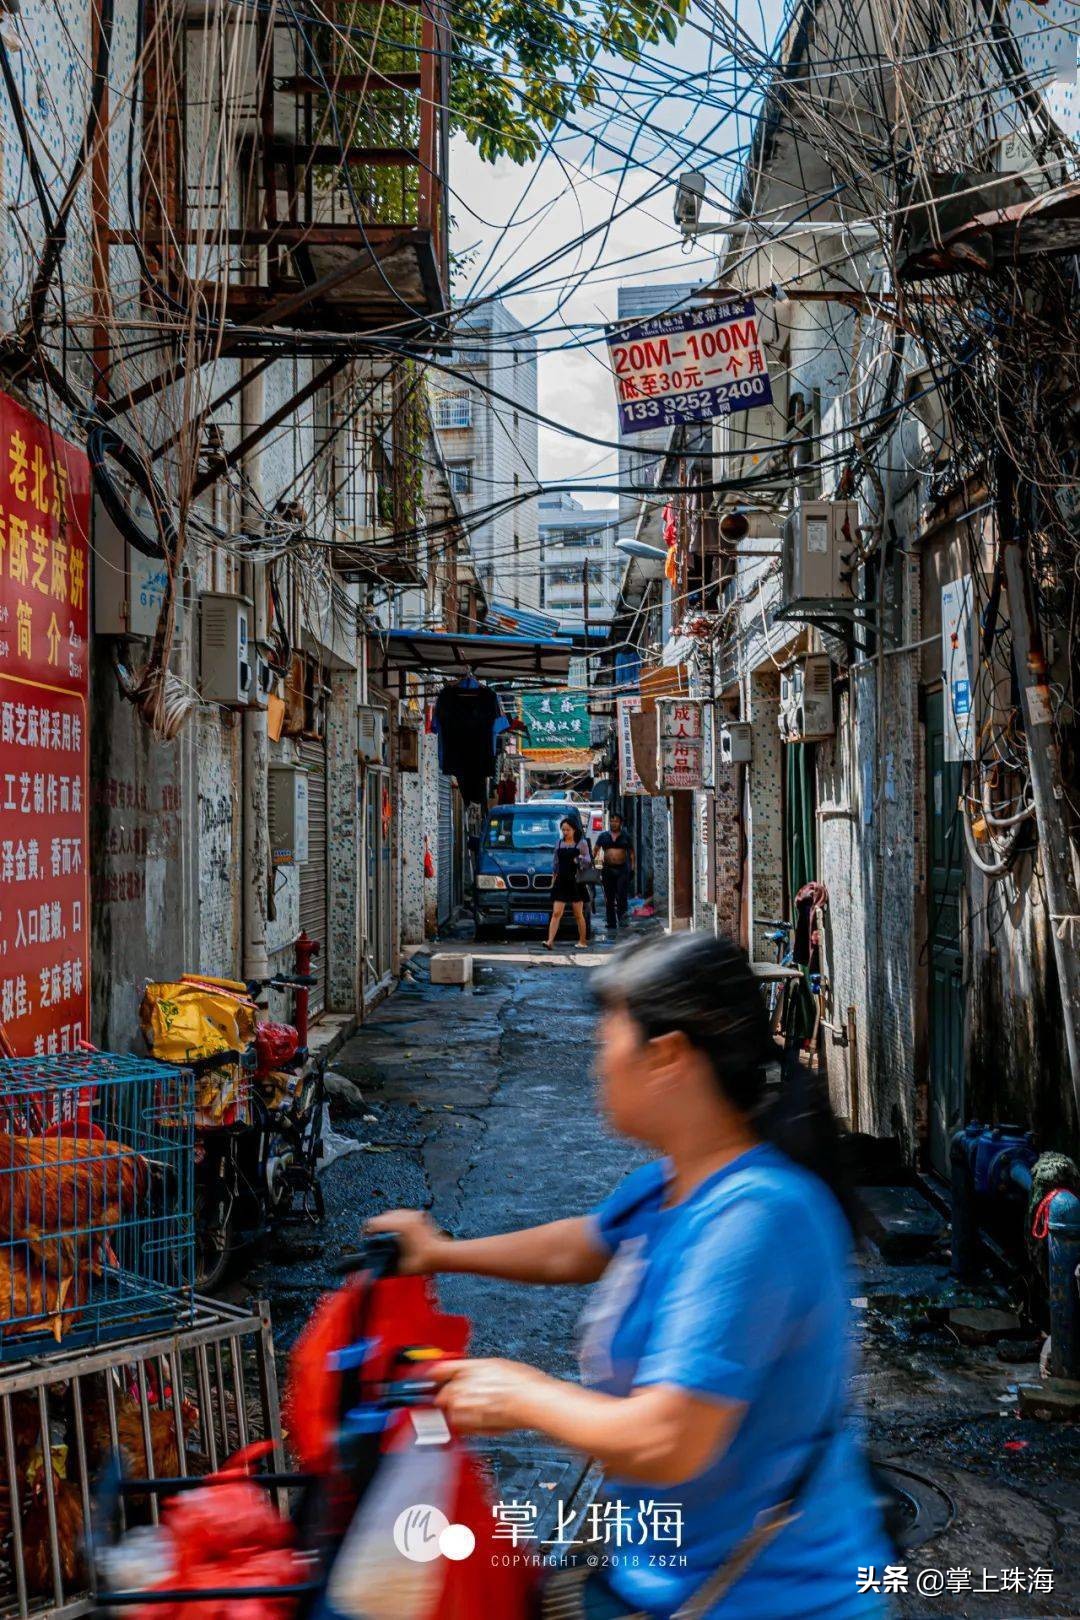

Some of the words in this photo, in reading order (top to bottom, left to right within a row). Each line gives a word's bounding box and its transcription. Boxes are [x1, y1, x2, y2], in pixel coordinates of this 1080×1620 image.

[619, 349, 765, 401] 低至30元一个月
[624, 401, 660, 421] 133
[663, 390, 713, 414] 9252
[716, 377, 764, 404] 2400
[9, 429, 68, 522] 老北京
[0, 504, 84, 611] 酥芝麻饼
[17, 598, 61, 666] 简介
[3, 771, 81, 814] 工艺制作而成
